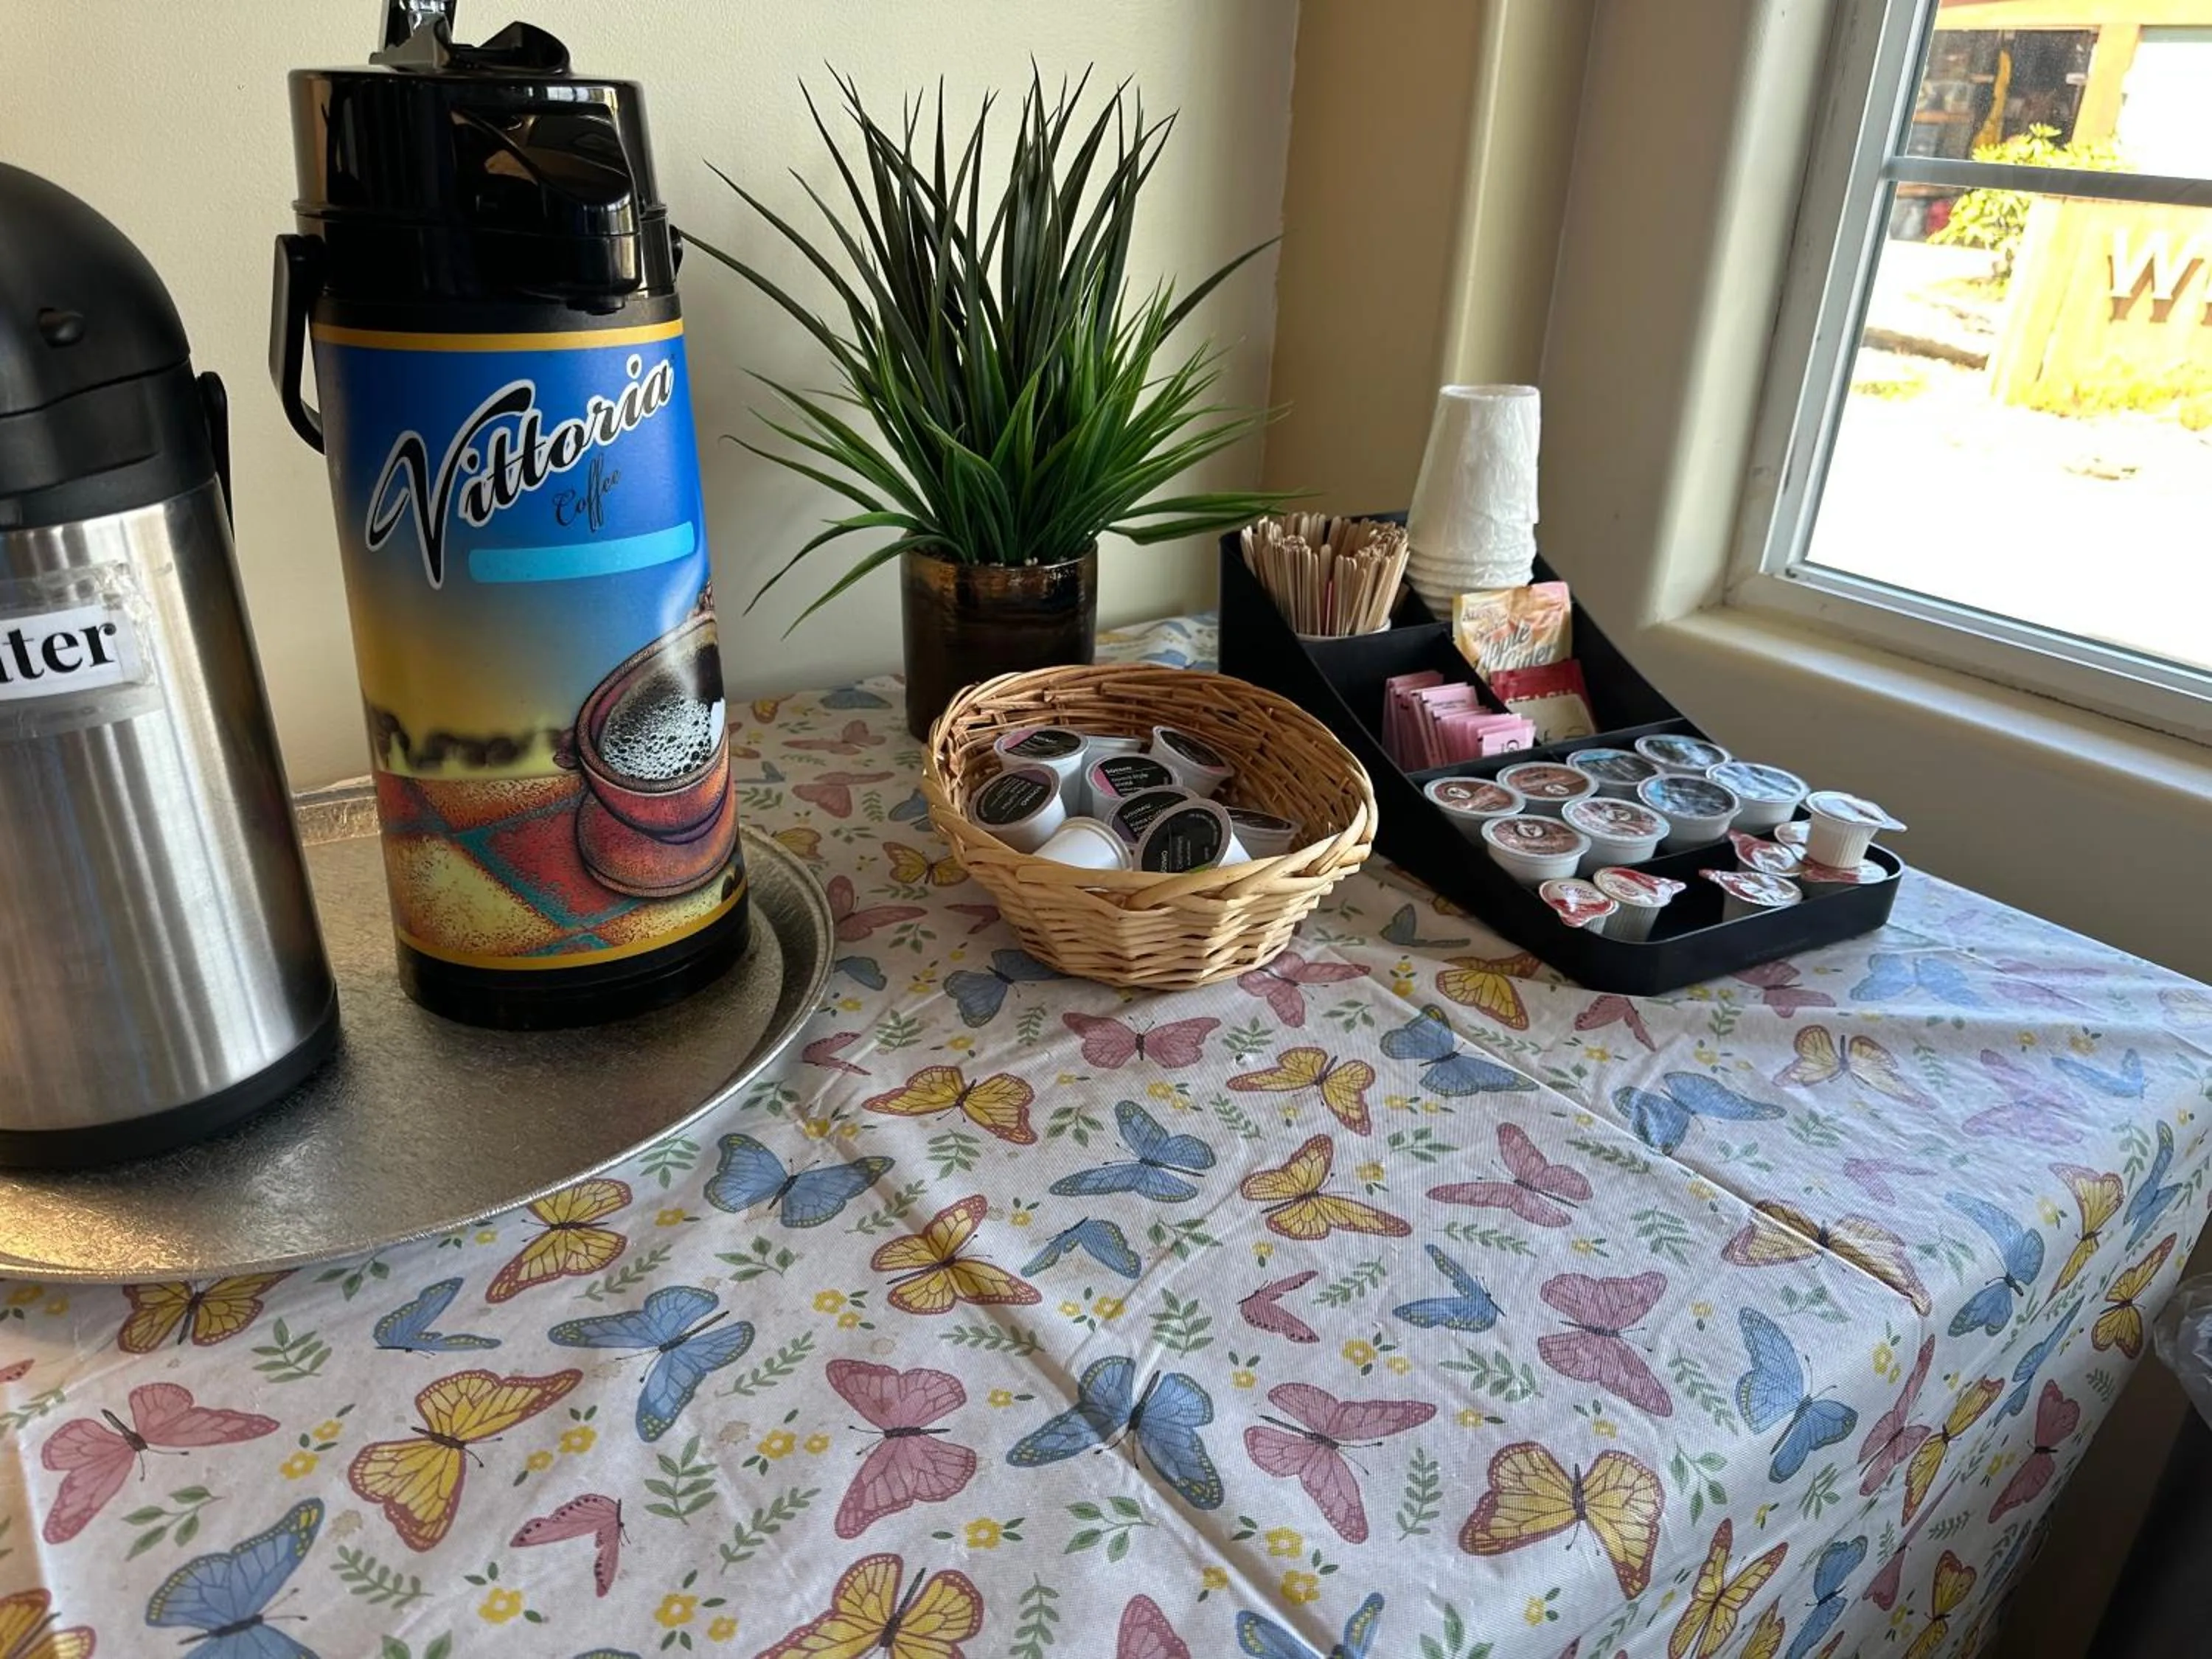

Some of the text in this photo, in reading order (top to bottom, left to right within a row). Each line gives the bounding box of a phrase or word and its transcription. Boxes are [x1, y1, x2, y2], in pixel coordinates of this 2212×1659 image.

[2107, 229, 2212, 326] W
[365, 354, 675, 590] Vittoria
[551, 453, 621, 533] Coffee
[1477, 618, 1531, 669] Apple
